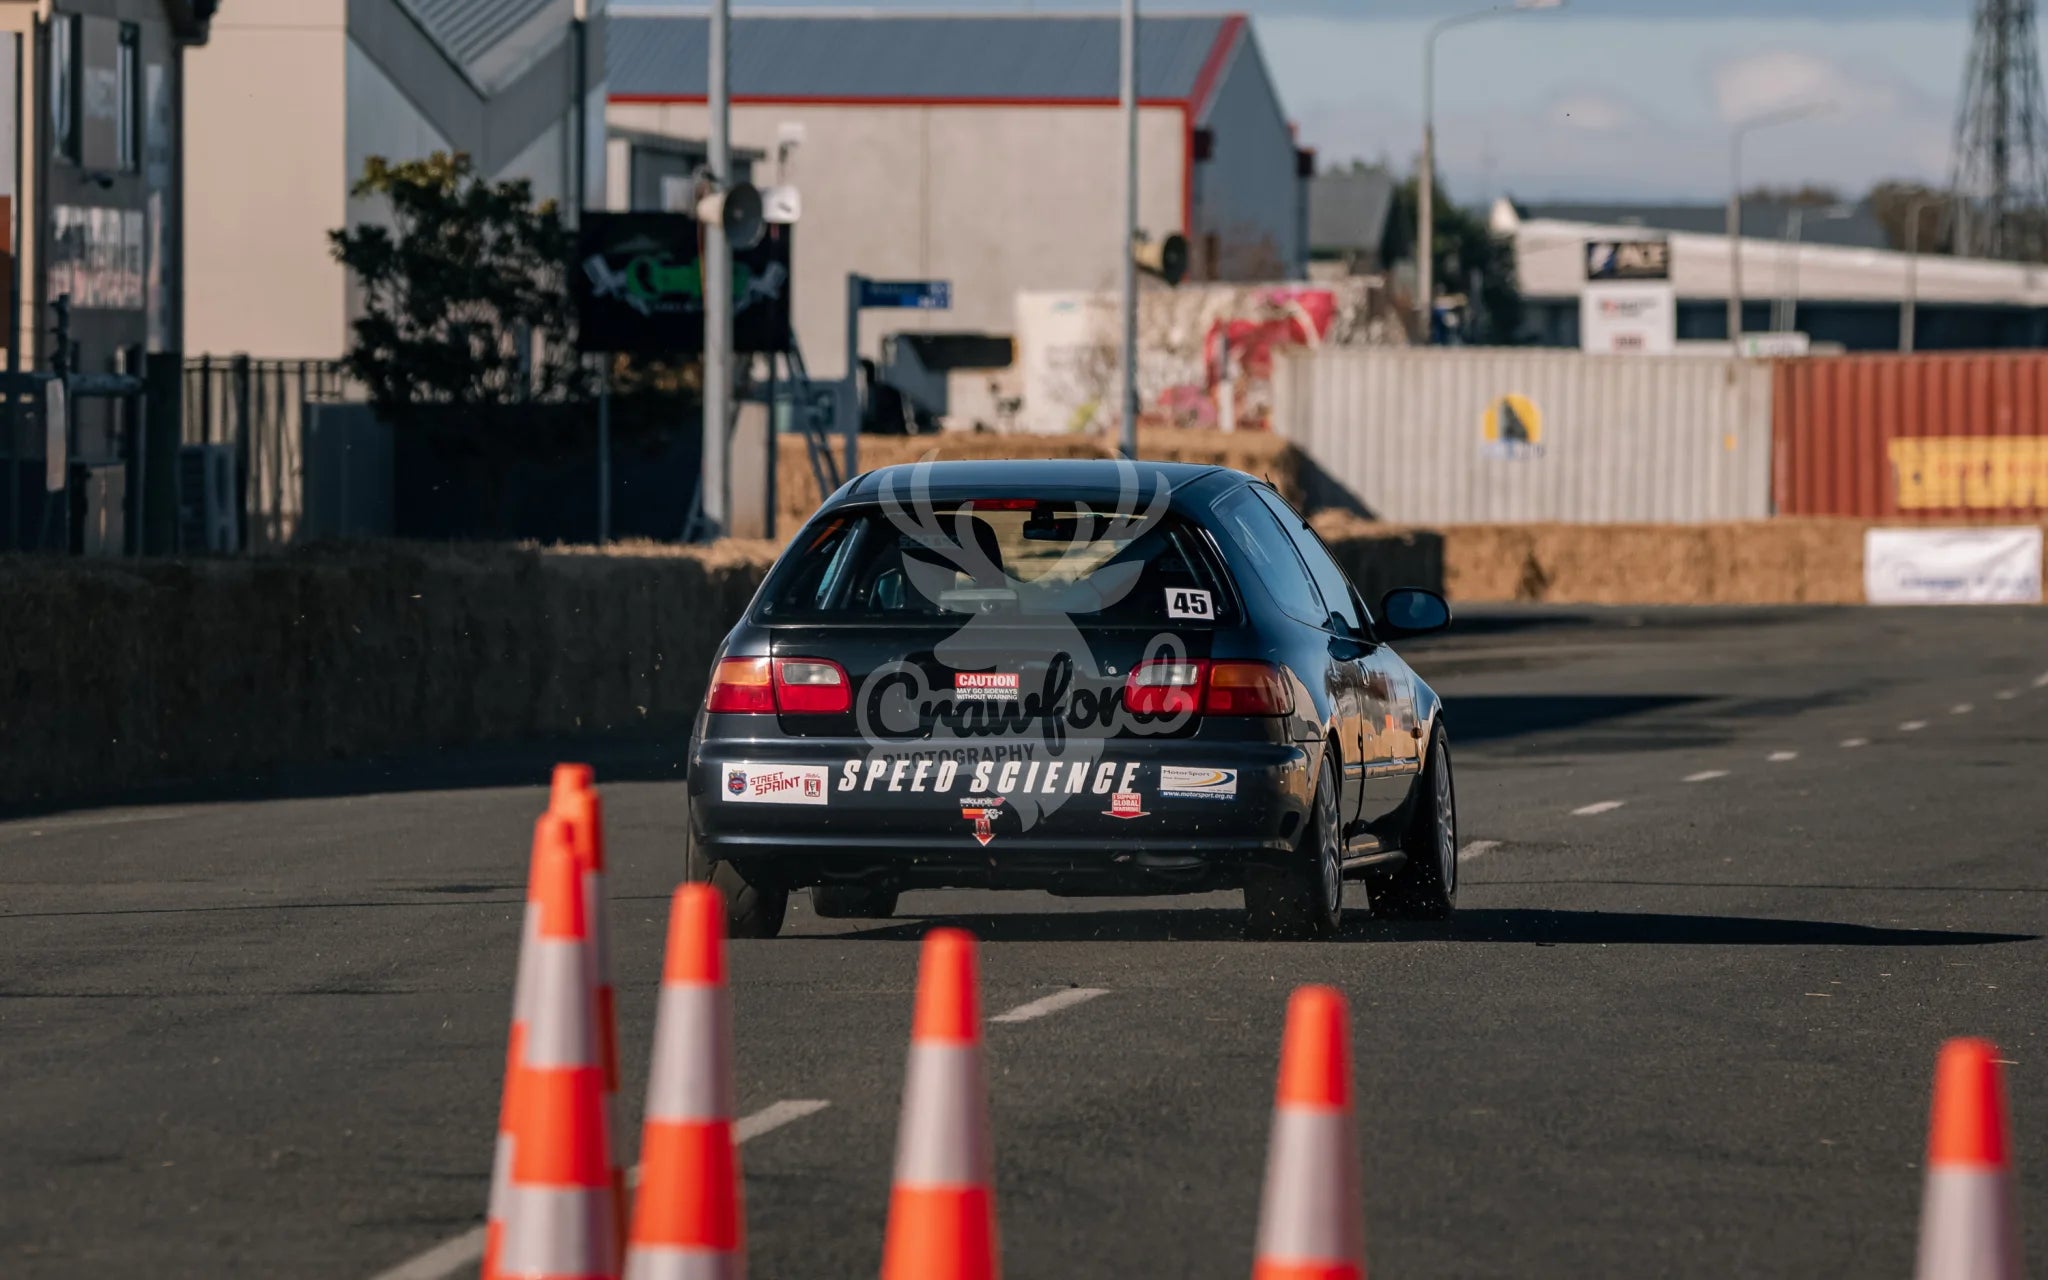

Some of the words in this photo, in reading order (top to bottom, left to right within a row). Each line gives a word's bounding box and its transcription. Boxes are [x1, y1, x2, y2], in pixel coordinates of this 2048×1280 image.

[1173, 592, 1208, 615] 45
[958, 674, 1016, 687] CAUTION
[750, 771, 784, 786] STREET
[837, 759, 959, 793] SPEED
[969, 761, 1141, 794] SCIENCE
[1163, 769, 1210, 777] MotorSport
[755, 776, 801, 796] SPRINT
[1163, 791, 1234, 800] www.motorsport.org.nz
